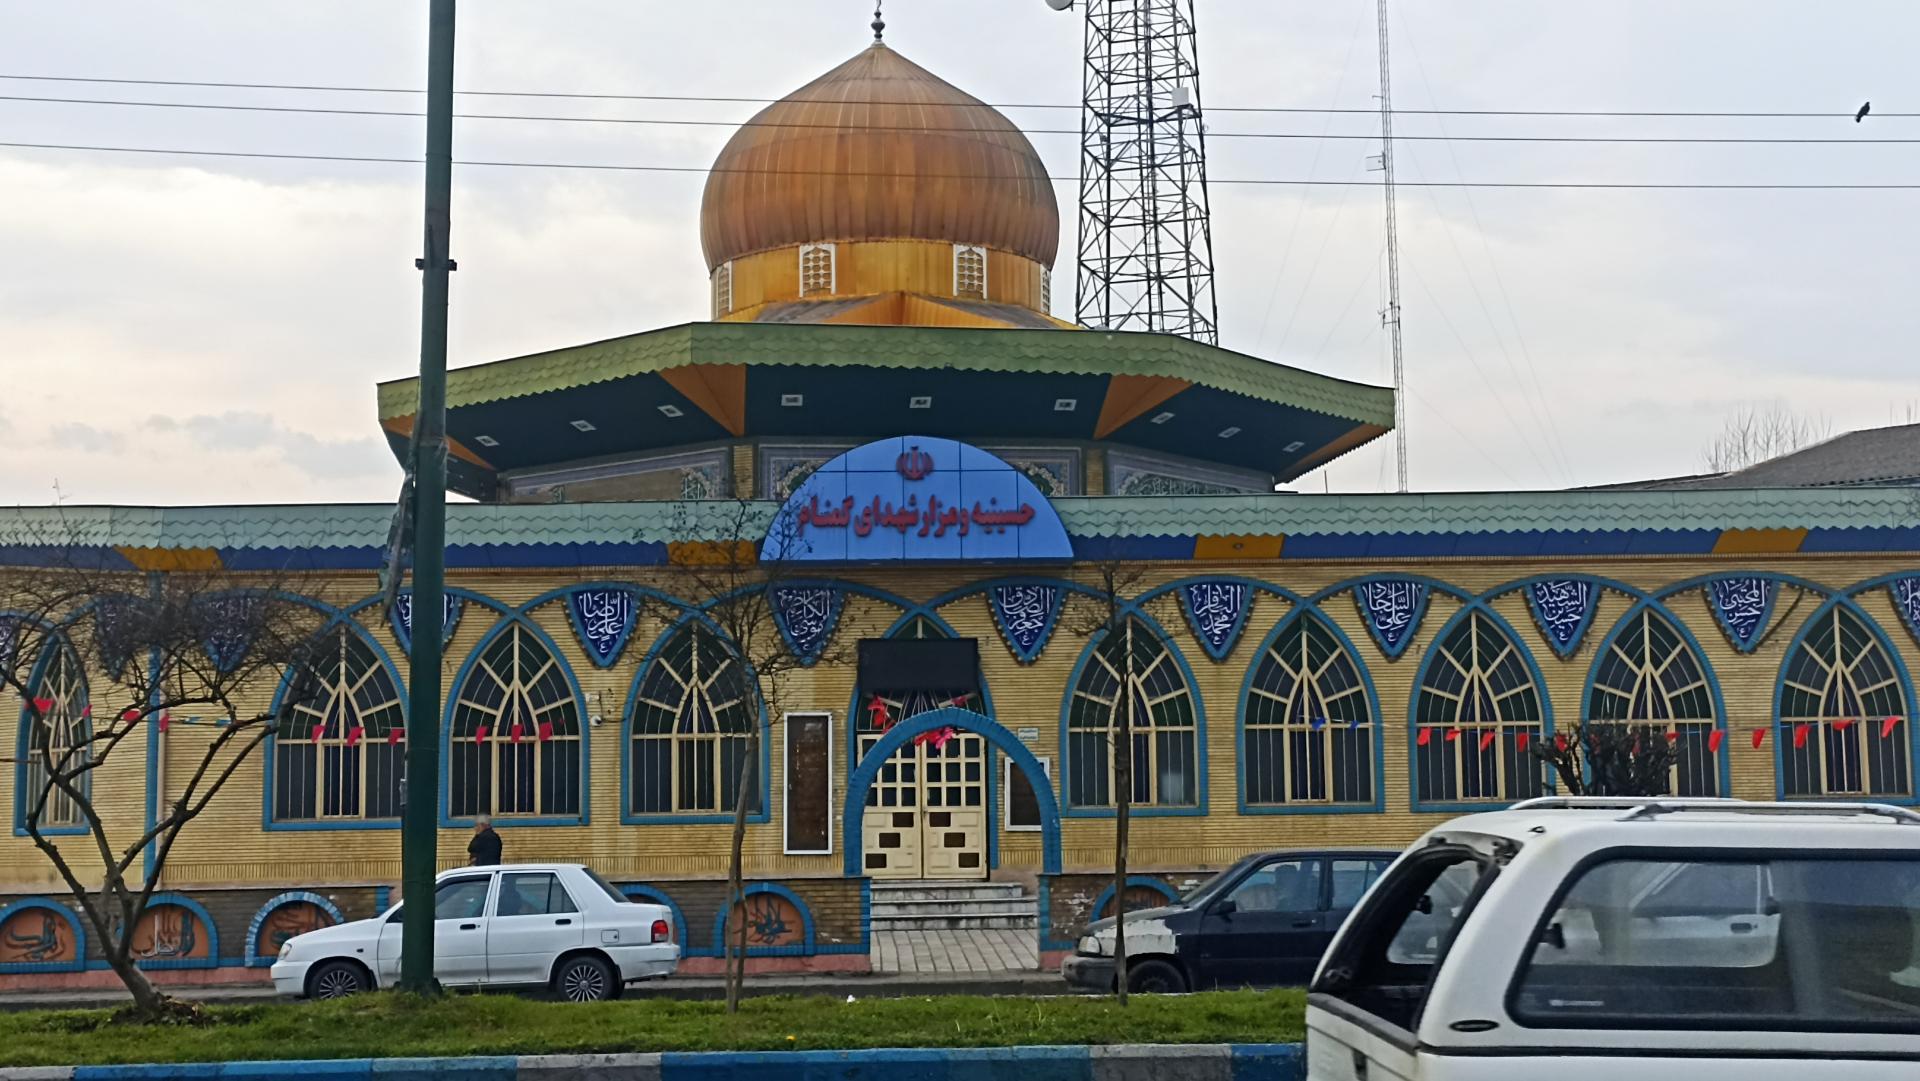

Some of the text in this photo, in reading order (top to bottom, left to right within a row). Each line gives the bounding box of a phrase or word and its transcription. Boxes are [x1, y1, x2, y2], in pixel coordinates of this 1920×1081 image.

[854, 493, 919, 537] شهدای
[917, 494, 957, 537] مزار
[957, 507, 969, 537] و
[972, 497, 1036, 534] حسینیه
